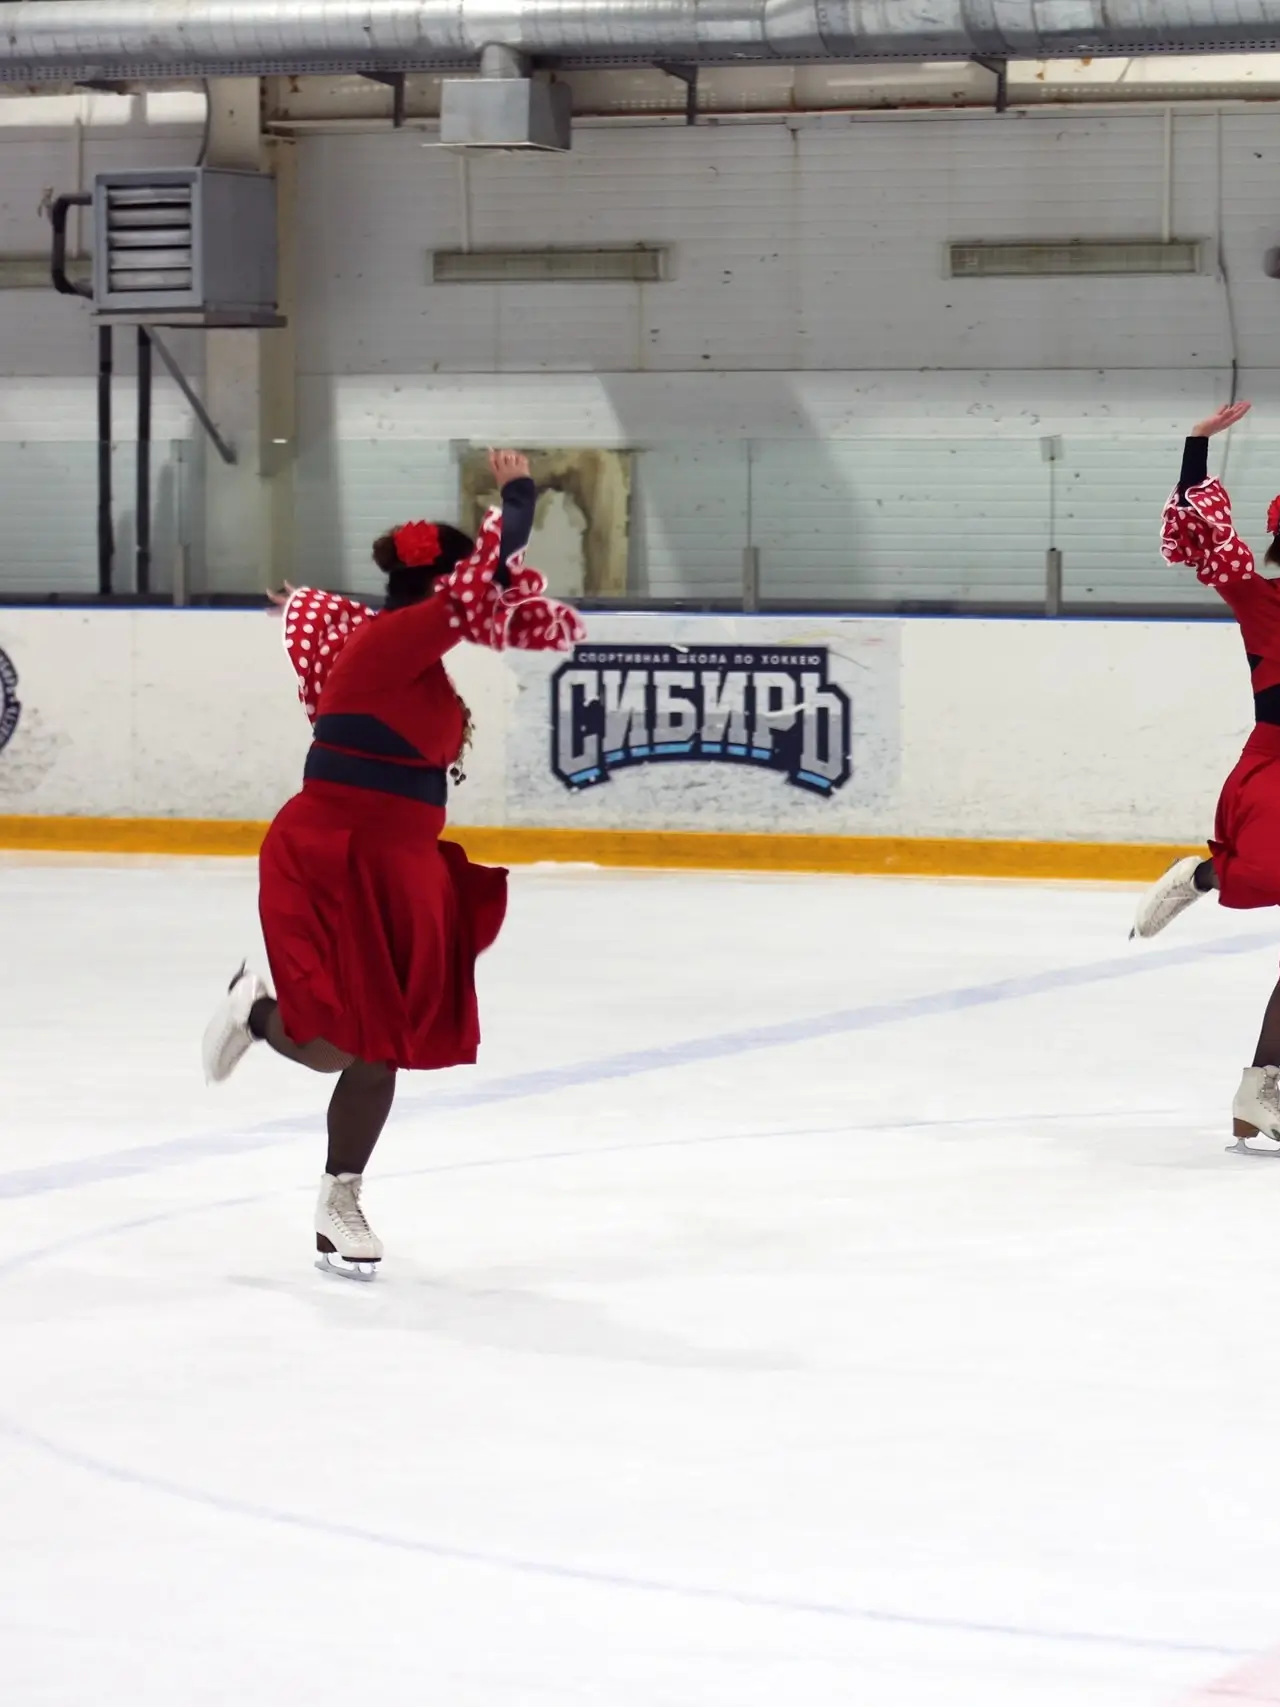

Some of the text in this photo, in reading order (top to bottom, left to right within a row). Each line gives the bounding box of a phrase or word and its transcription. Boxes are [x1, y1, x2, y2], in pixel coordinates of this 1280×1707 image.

[578, 652, 821, 665] СПОРТИВНАЯ ШКОЛА ПО ХОККЕЮ
[557, 669, 843, 781] СИБИРЬ
